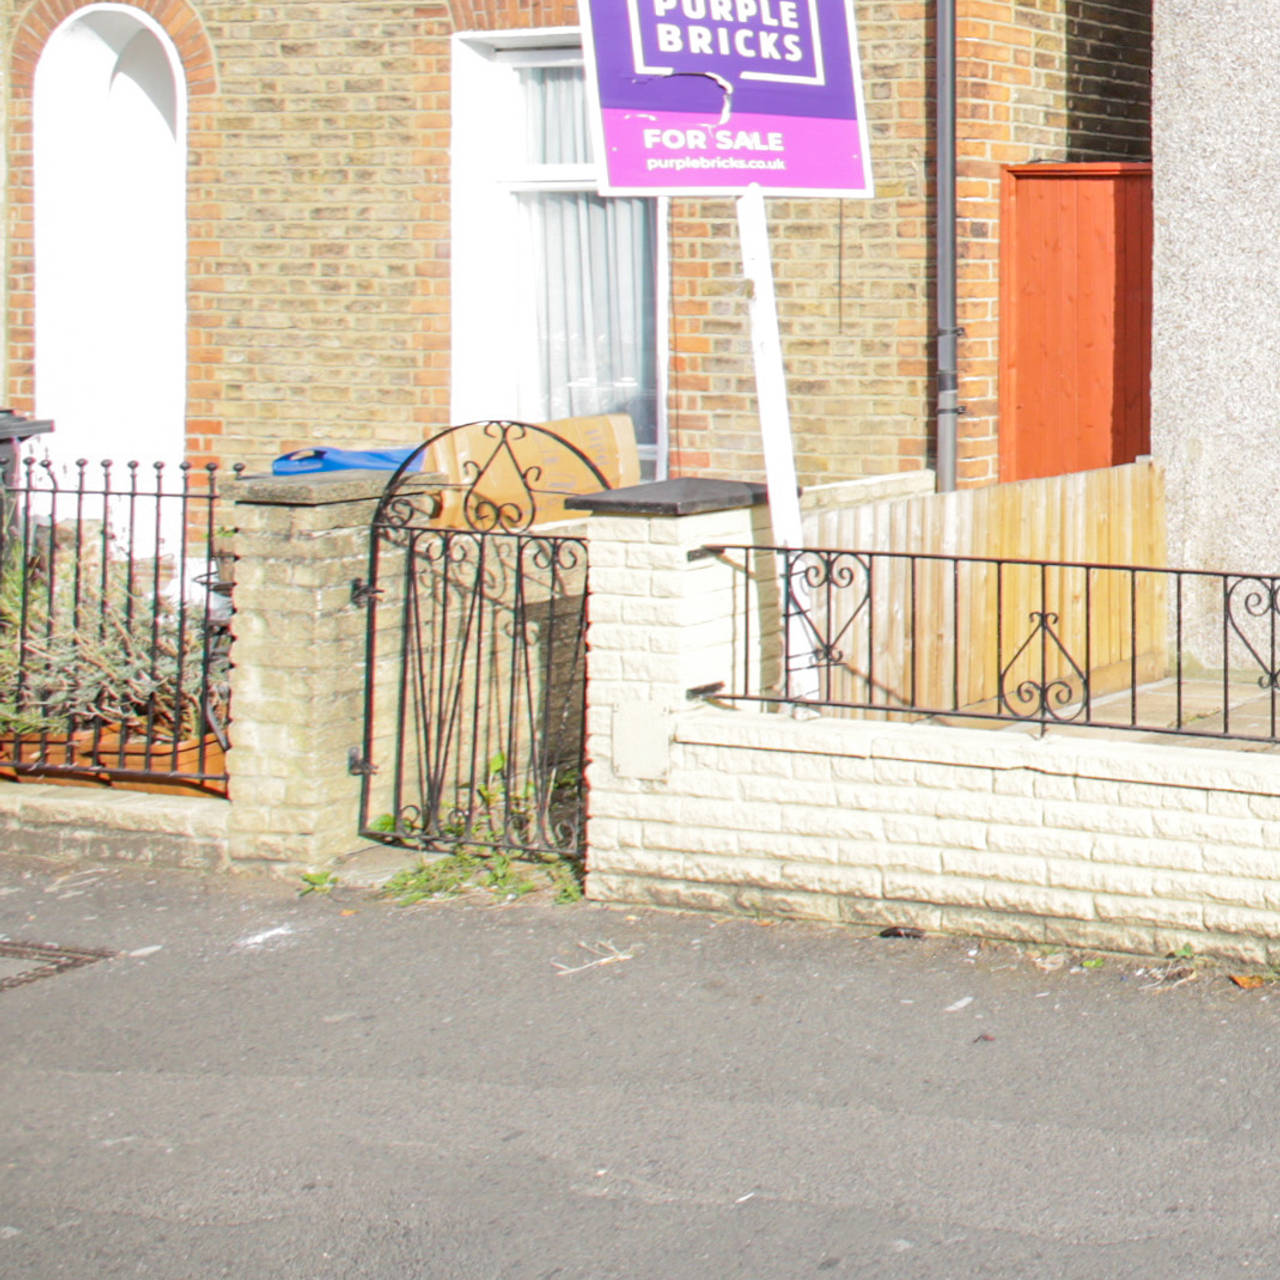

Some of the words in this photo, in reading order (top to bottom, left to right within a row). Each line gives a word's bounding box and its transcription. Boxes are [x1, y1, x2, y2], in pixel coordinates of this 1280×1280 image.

[656, 23, 803, 62] BRICKS
[643, 129, 707, 150] FOR
[715, 130, 785, 151] SALE
[646, 156, 786, 171] purplebricks.co.uk
